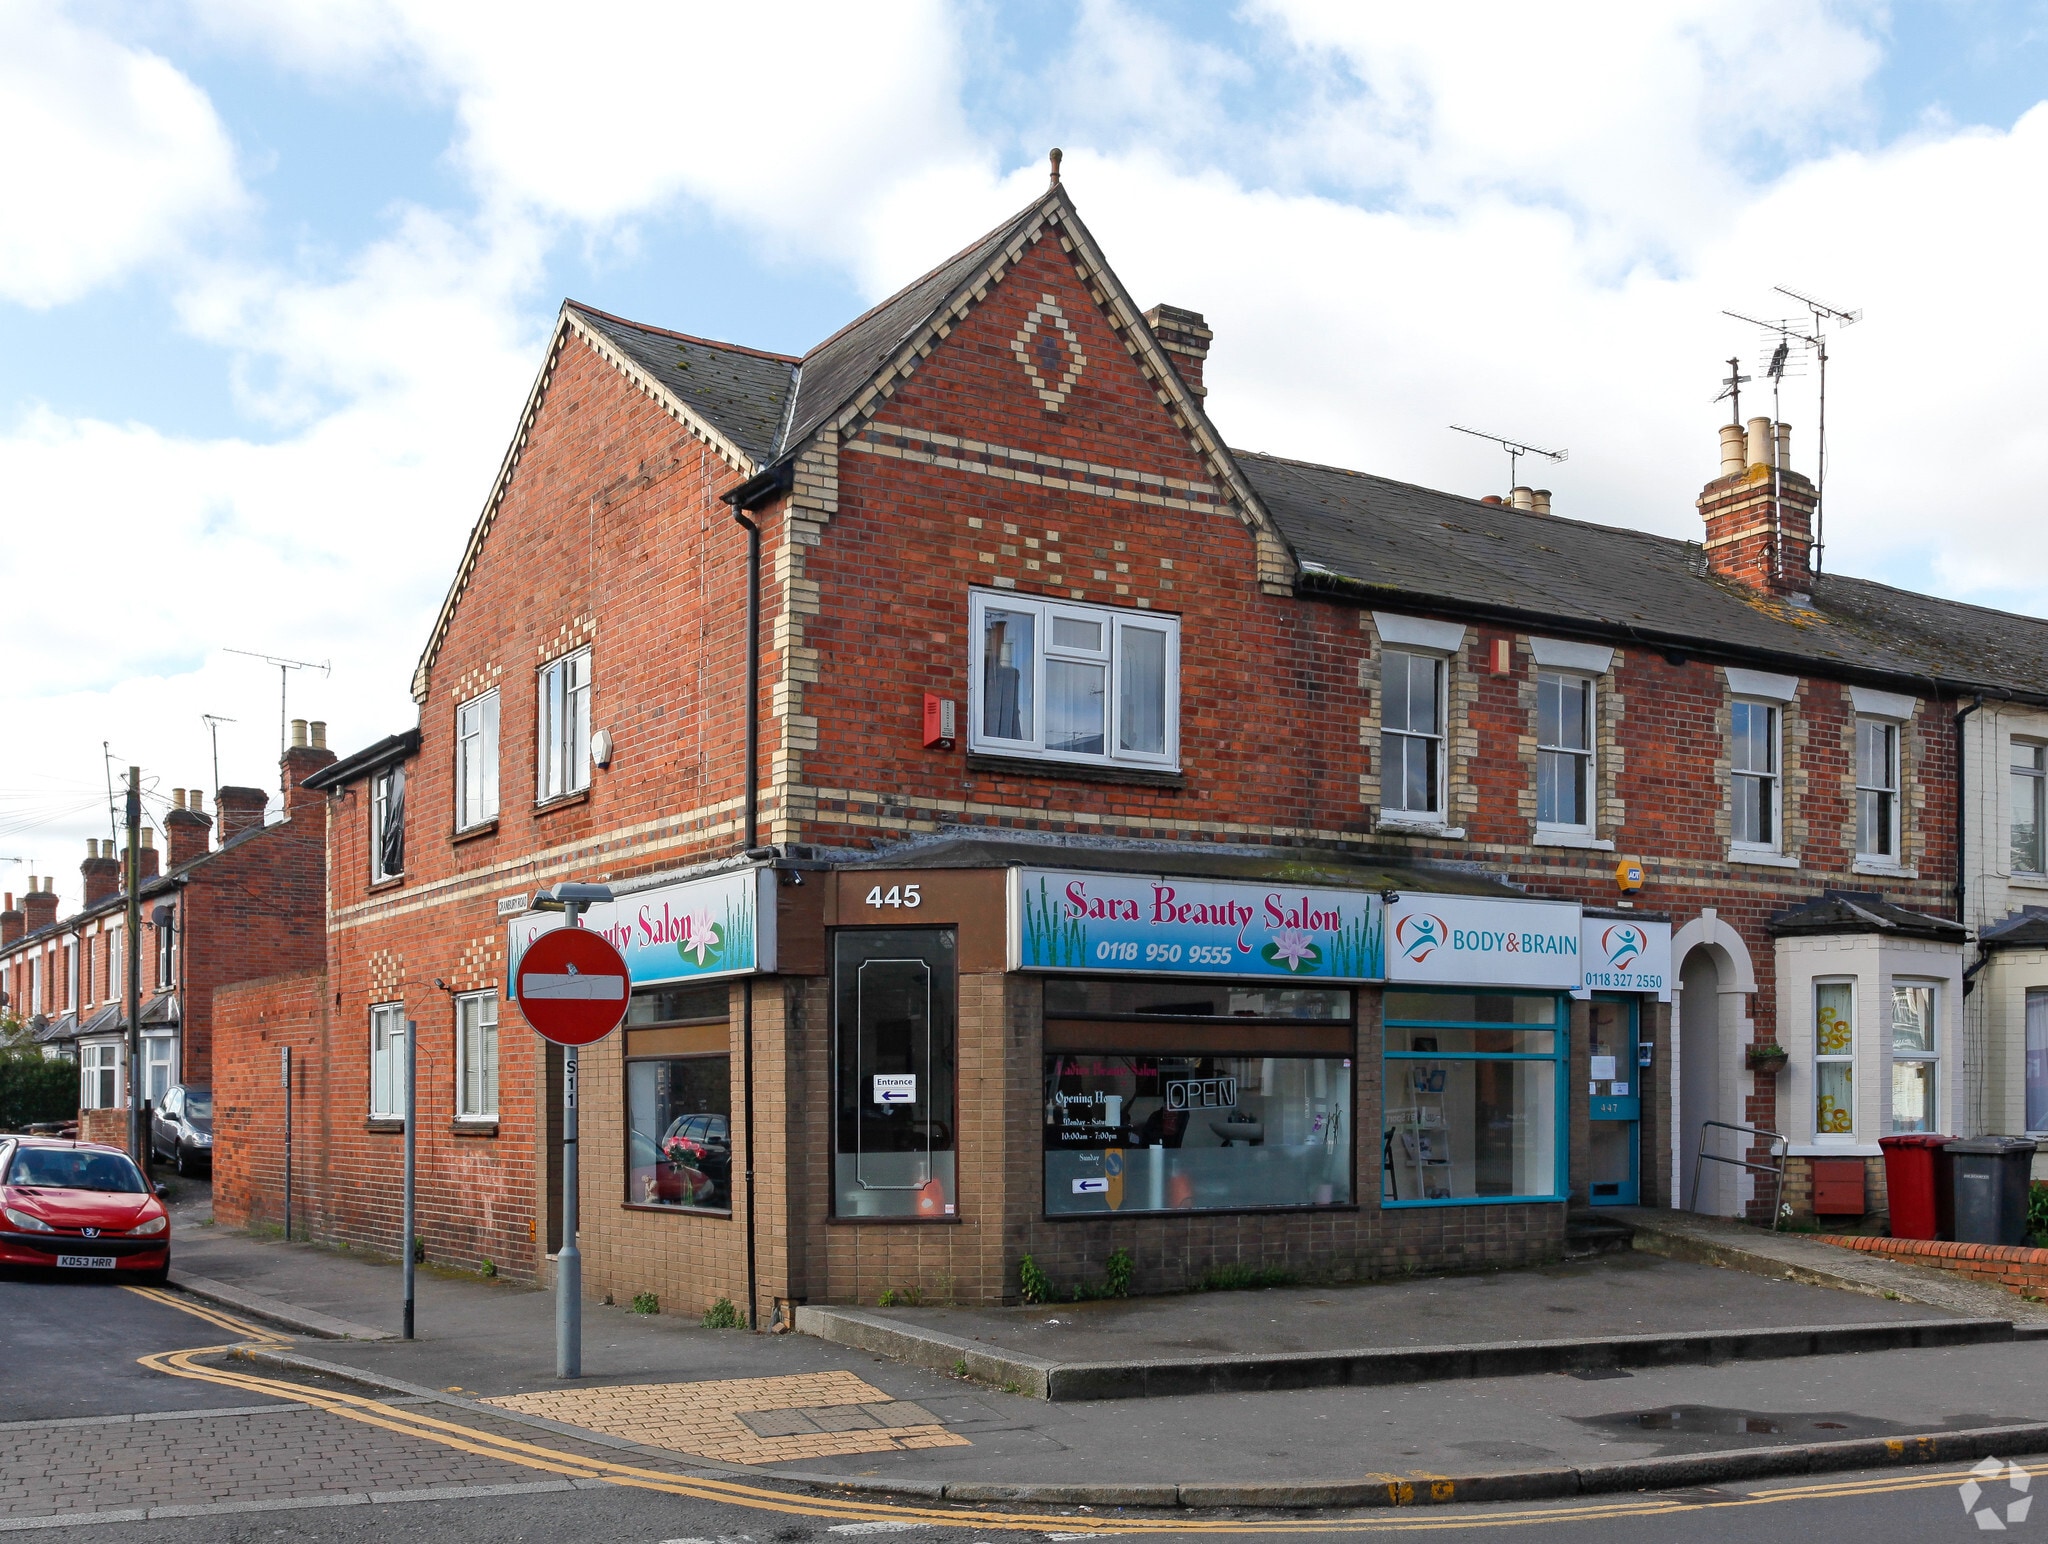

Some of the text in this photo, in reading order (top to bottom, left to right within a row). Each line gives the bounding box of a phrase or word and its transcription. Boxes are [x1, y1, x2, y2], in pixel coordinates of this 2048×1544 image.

[1628, 871, 1640, 880] ADT
[517, 896, 527, 908] ROAD
[865, 884, 922, 909] 445
[1064, 880, 1341, 953] Sara Beauty Salon
[637, 901, 692, 951] Salon
[1453, 929, 1577, 955] BODY&BRAIN
[1096, 941, 1232, 964] 0118 950 9555
[1585, 972, 1662, 988] 0118 327 2550
[1129, 1062, 1157, 1076] Salon
[877, 1078, 913, 1087] Entrance
[1055, 1089, 1122, 1107] Opening Hos
[1170, 1080, 1233, 1108] OPEN
[1600, 1103, 1618, 1113] 447
[1063, 1118, 1085, 1130] Monday
[1061, 1132, 1088, 1140] 10:00am
[1095, 1131, 1117, 1142] 7:00pm
[1079, 1154, 1100, 1165] Sunday
[61, 1257, 112, 1268] KD53 HRR
